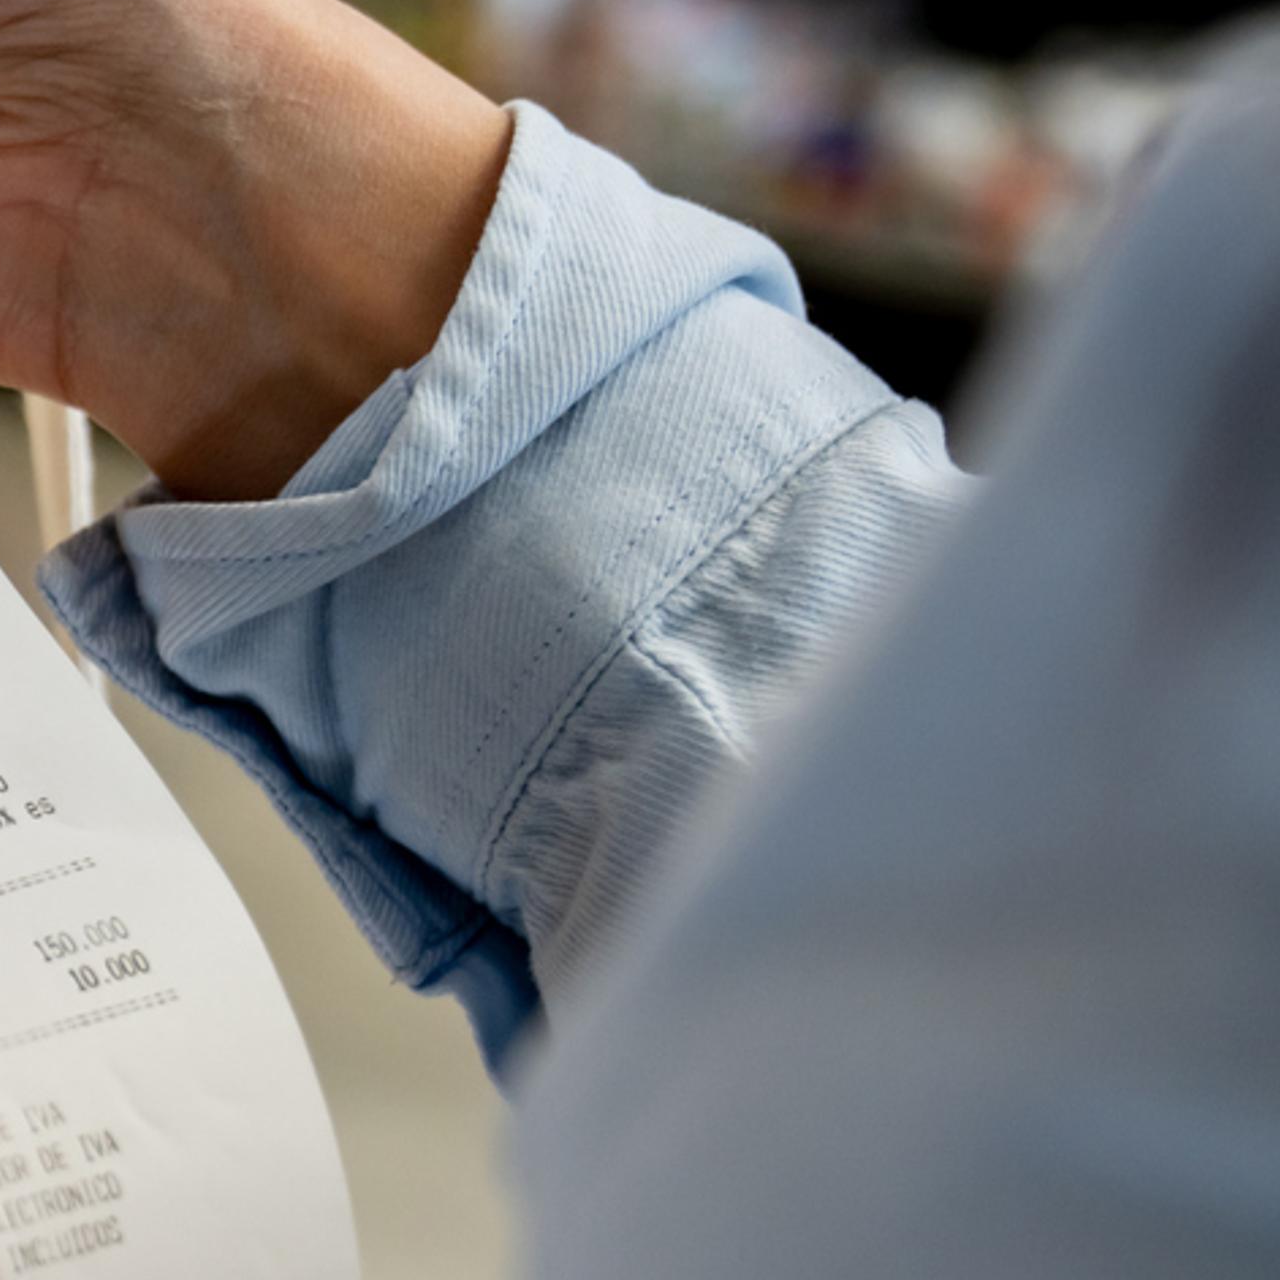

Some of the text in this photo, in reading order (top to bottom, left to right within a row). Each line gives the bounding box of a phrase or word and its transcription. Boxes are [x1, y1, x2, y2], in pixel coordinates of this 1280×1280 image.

[25, 797, 56, 819] es
[33, 915, 131, 964] 150.000
[69, 949, 151, 993] 10.000
[79, 1130, 121, 1162] IVA
